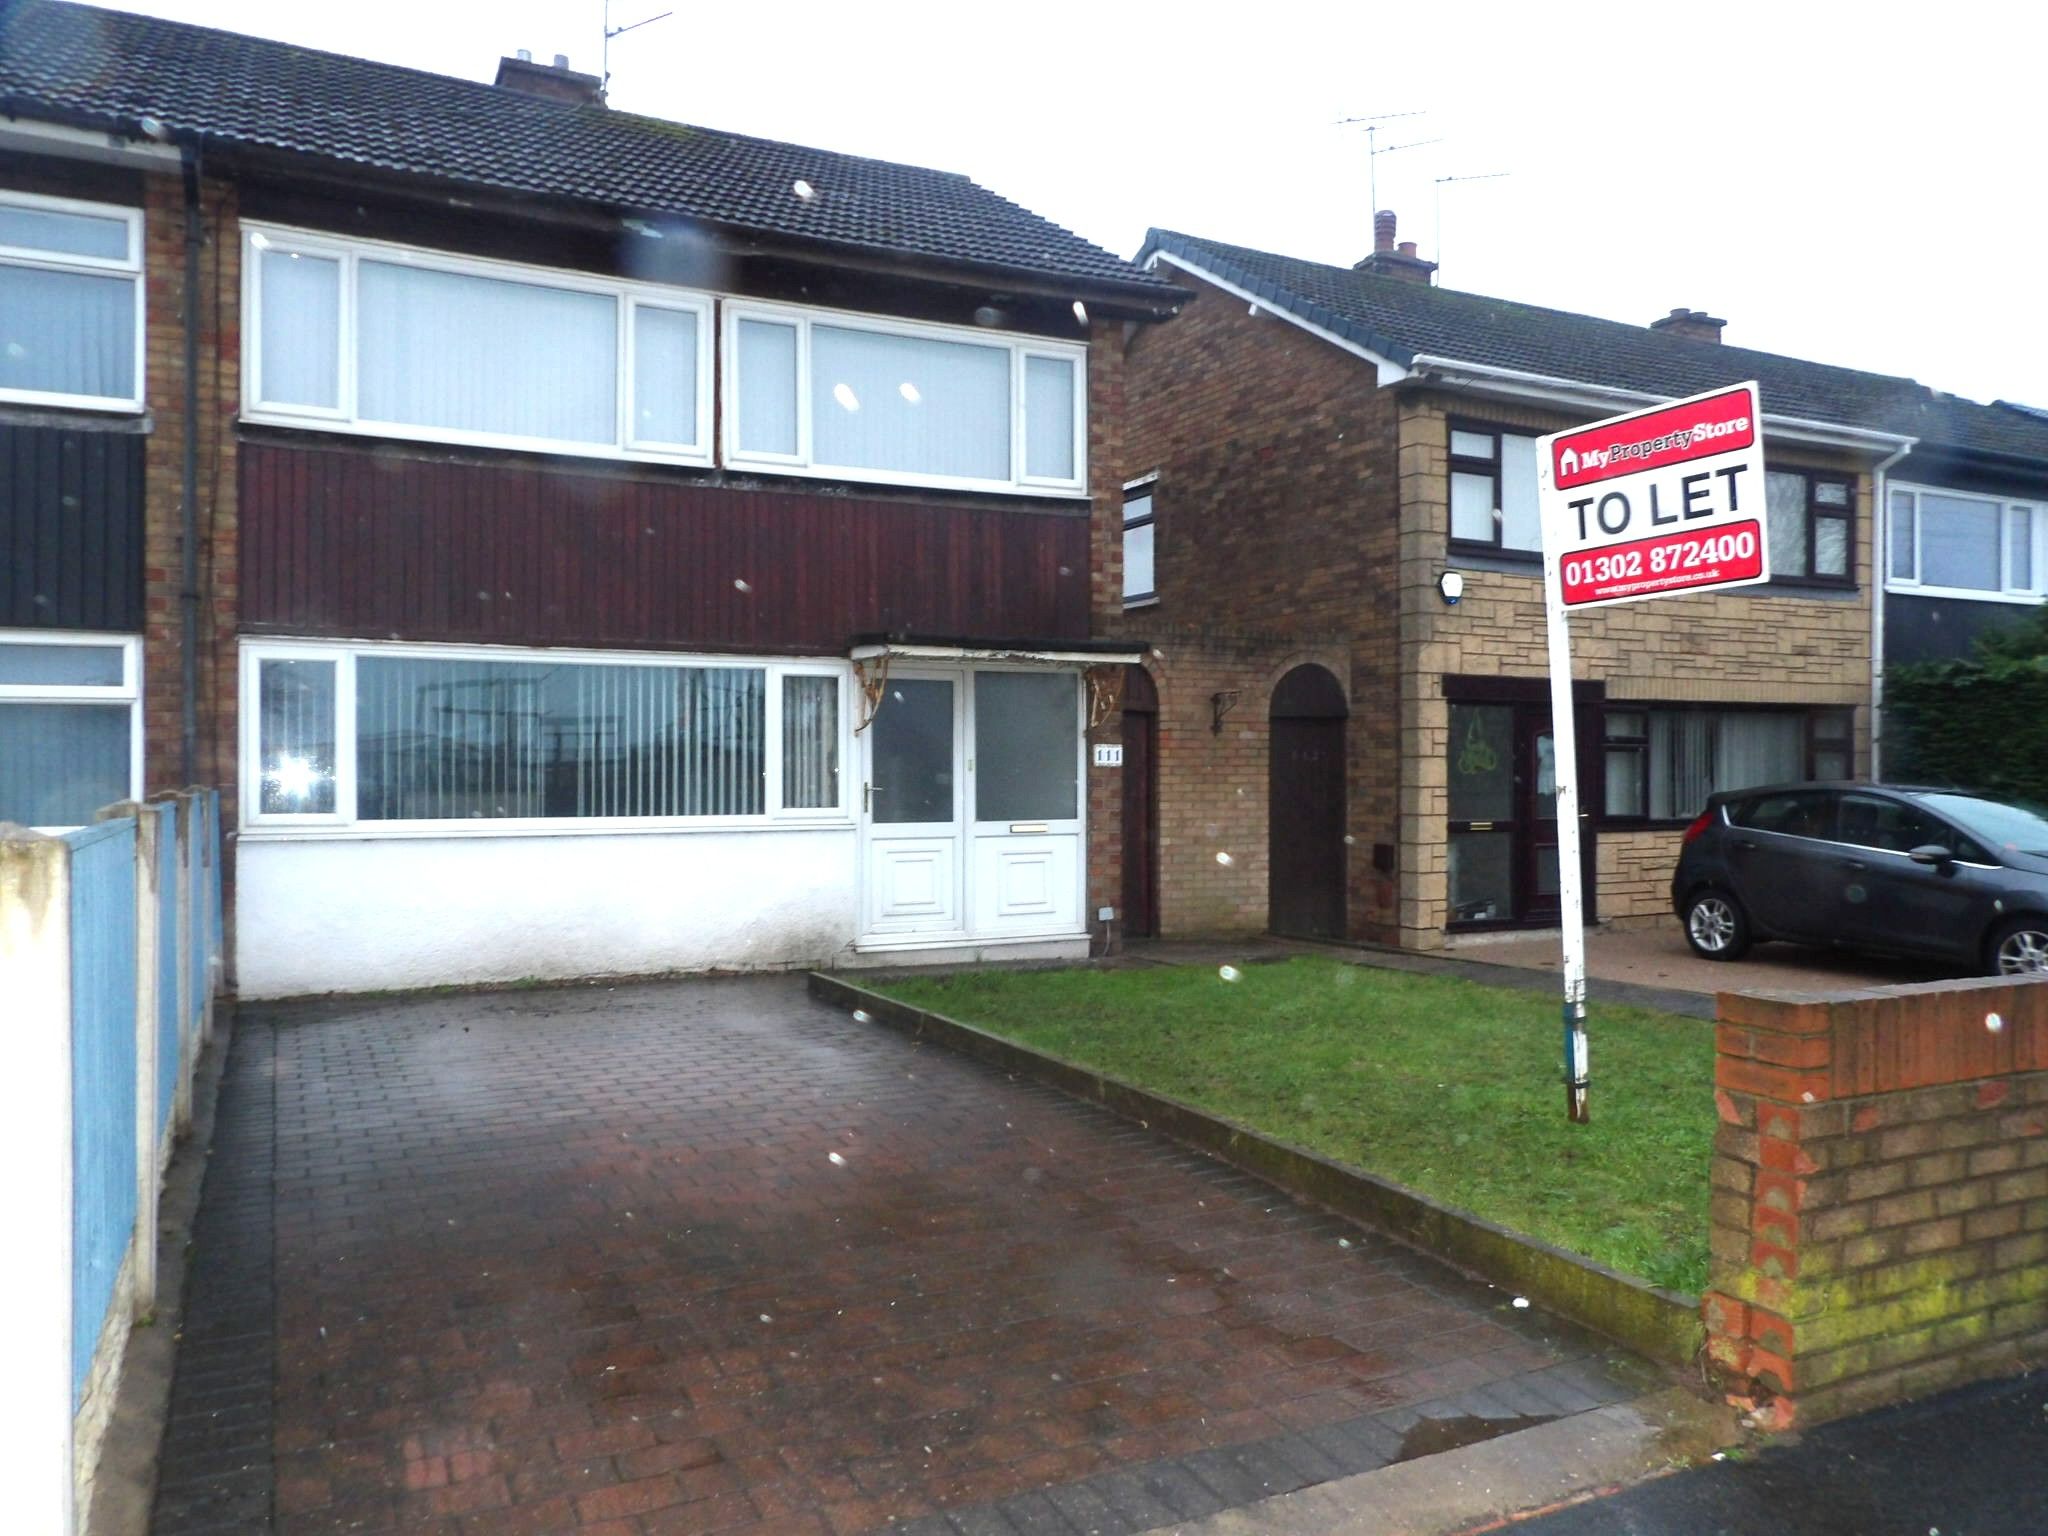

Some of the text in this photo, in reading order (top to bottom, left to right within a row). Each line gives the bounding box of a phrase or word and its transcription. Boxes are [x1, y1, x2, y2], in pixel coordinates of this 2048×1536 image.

[1568, 463, 1748, 540] TO LET
[1565, 532, 1755, 586] 01302 872400
[1097, 750, 1120, 761] 111
